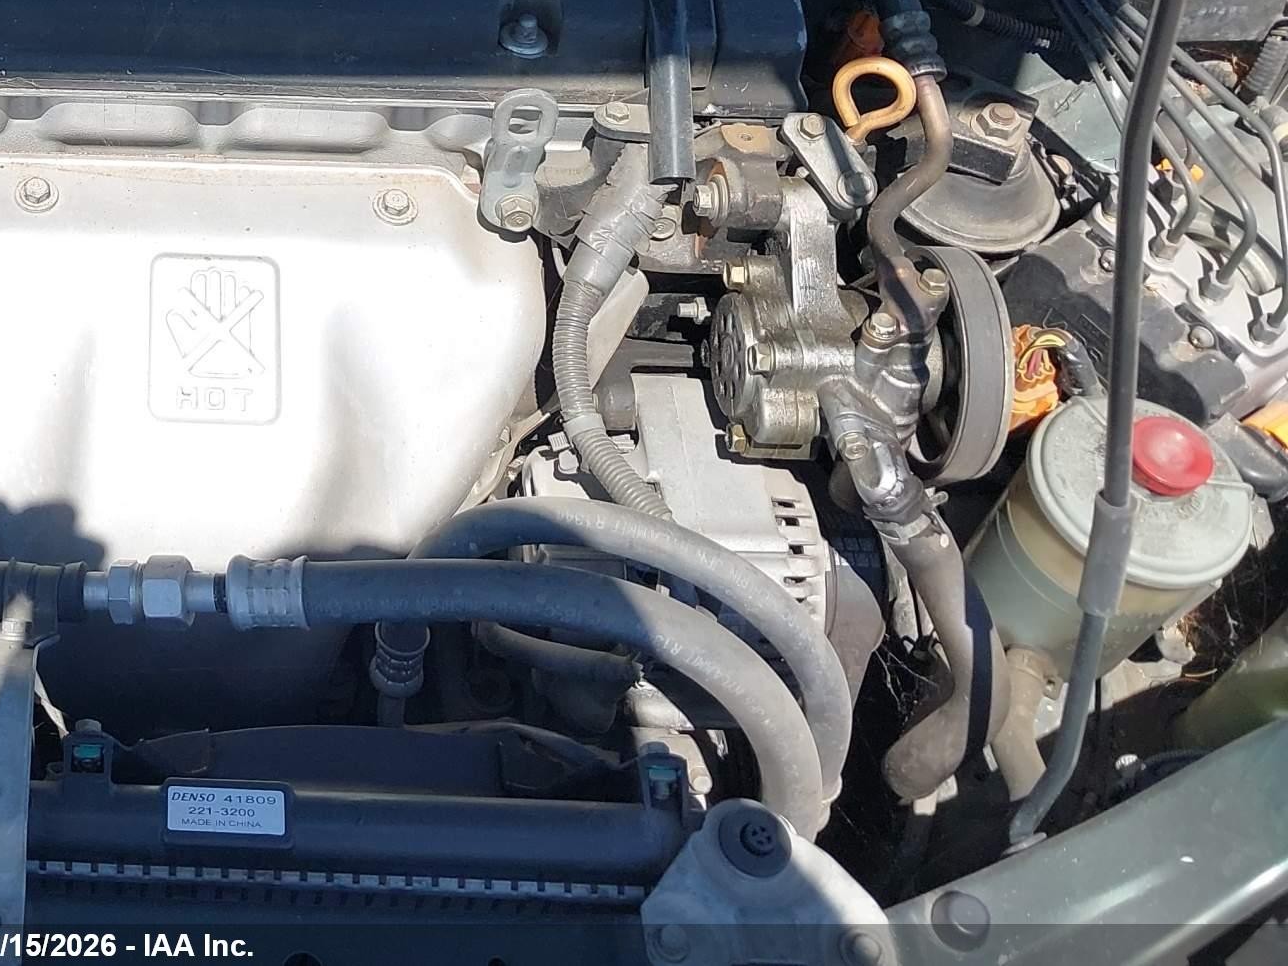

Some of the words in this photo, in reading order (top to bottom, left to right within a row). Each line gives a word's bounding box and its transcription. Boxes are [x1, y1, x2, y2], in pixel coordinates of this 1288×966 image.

[176, 386, 255, 412] HOT
[171, 791, 216, 803] DENSO
[223, 794, 277, 805] 41809
[188, 806, 256, 818] 221-3200
[181, 818, 212, 827] MADE
[215, 818, 226, 827] IN
[228, 820, 263, 828] CHINA
